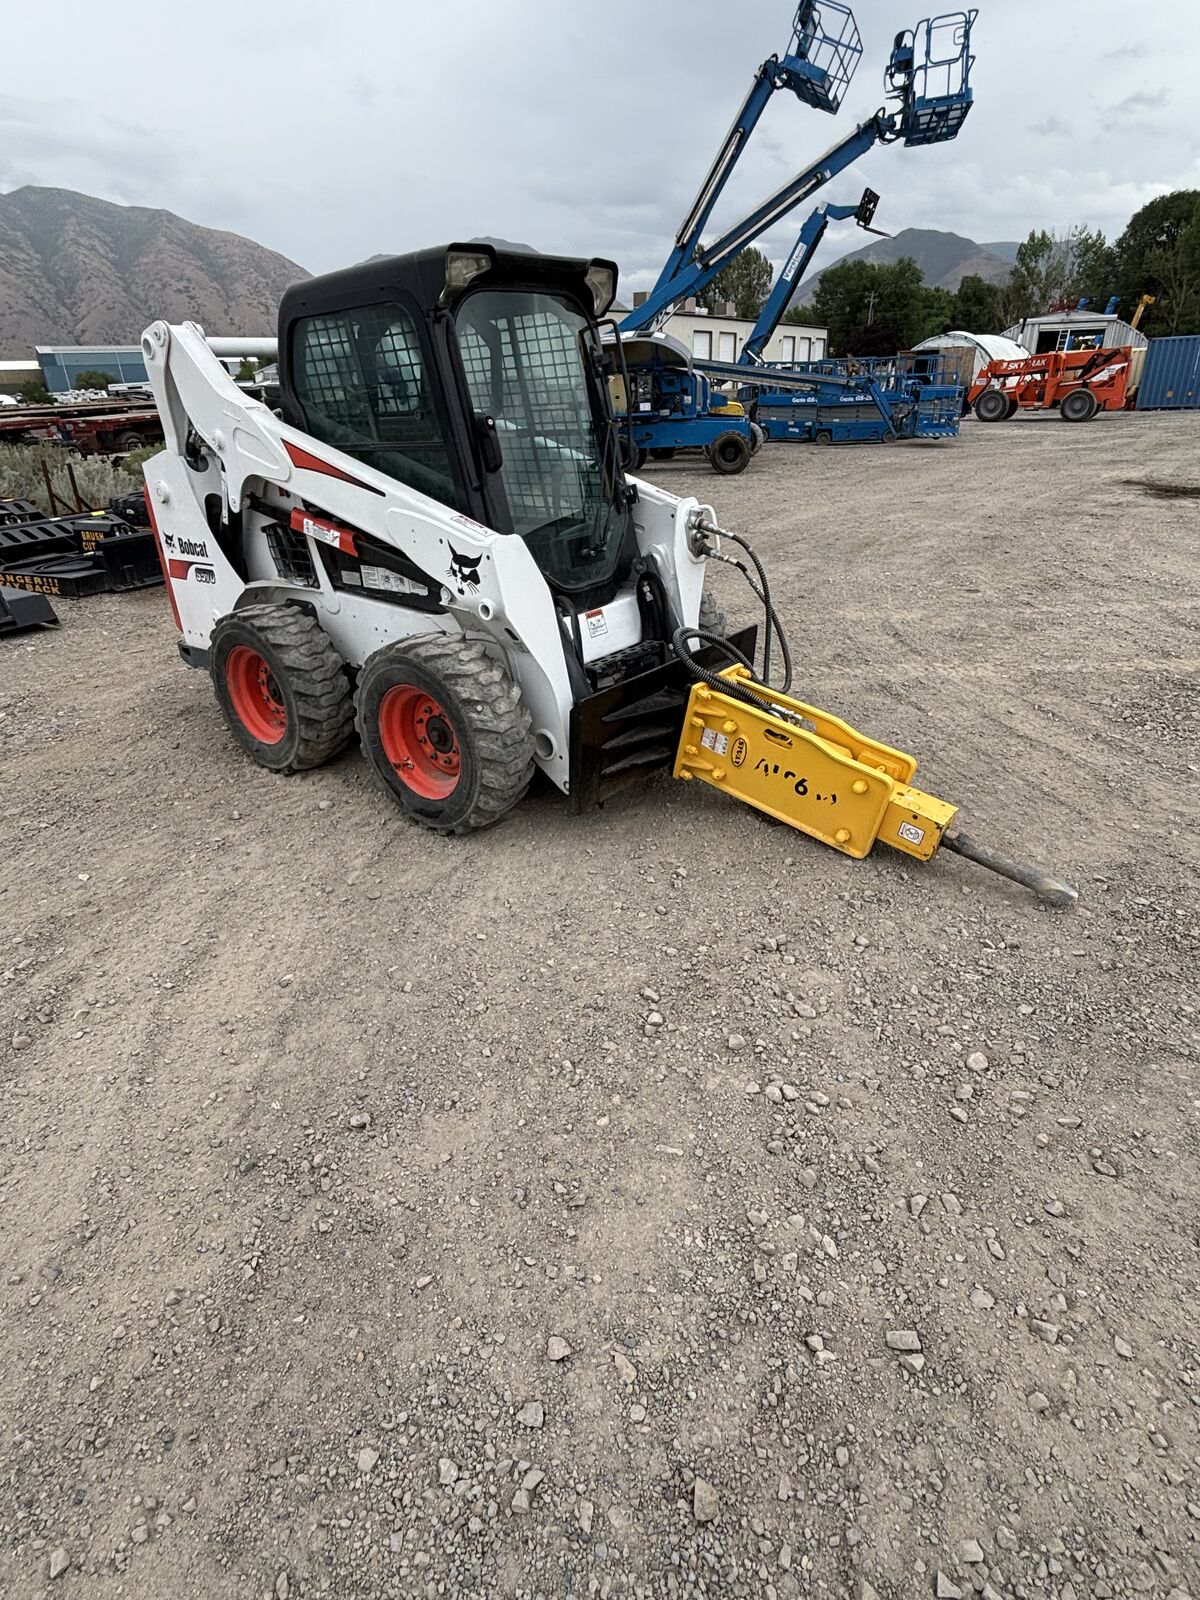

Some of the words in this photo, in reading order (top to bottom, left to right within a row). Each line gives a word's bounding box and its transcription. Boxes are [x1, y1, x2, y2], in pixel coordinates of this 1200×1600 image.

[80, 530, 105, 541] BRUSH
[82, 541, 97, 551] CUT
[177, 536, 209, 558] Bobcat
[0, 573, 59, 587] ANGER!!!
[25, 583, 62, 595] BACK
